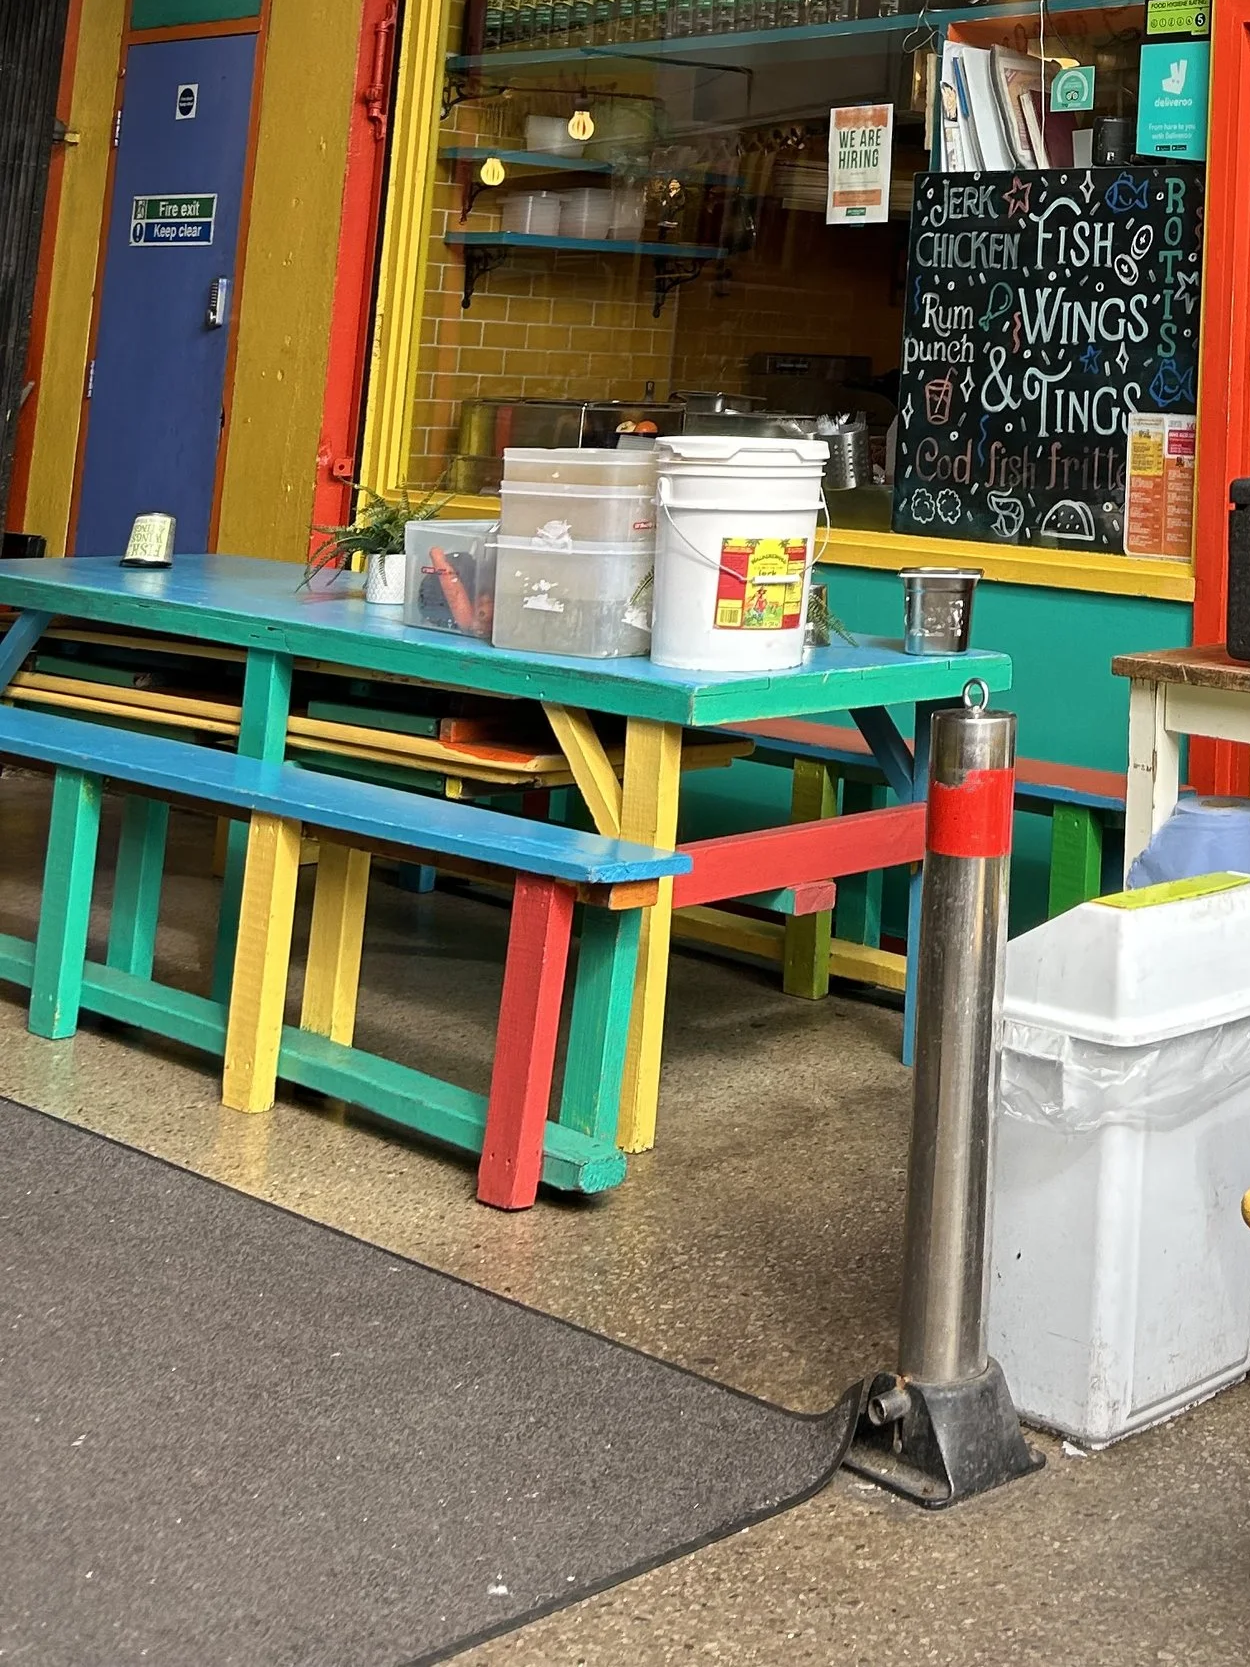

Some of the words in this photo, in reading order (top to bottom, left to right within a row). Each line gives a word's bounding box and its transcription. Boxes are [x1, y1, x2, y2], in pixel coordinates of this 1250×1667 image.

[1197, 15, 1204, 25] 5
[1154, 97, 1193, 107] deliveroo
[839, 130, 856, 148] WE
[860, 128, 882, 147] ARE
[838, 149, 879, 170] HIRING
[159, 201, 178, 217] Fire
[180, 200, 200, 216] exit
[930, 179, 999, 227] JERK
[153, 223, 177, 240] Keep
[178, 224, 202, 238] clear
[915, 231, 1021, 270] CHICKEN
[1029, 197, 1114, 270] FISH
[922, 292, 974, 337] Rum
[1018, 287, 1149, 345] WINGS
[903, 334, 975, 375] punch
[981, 346, 1022, 413] &
[916, 437, 973, 485] Cod
[985, 441, 1036, 489] fish
[1045, 441, 1127, 490] fritte
